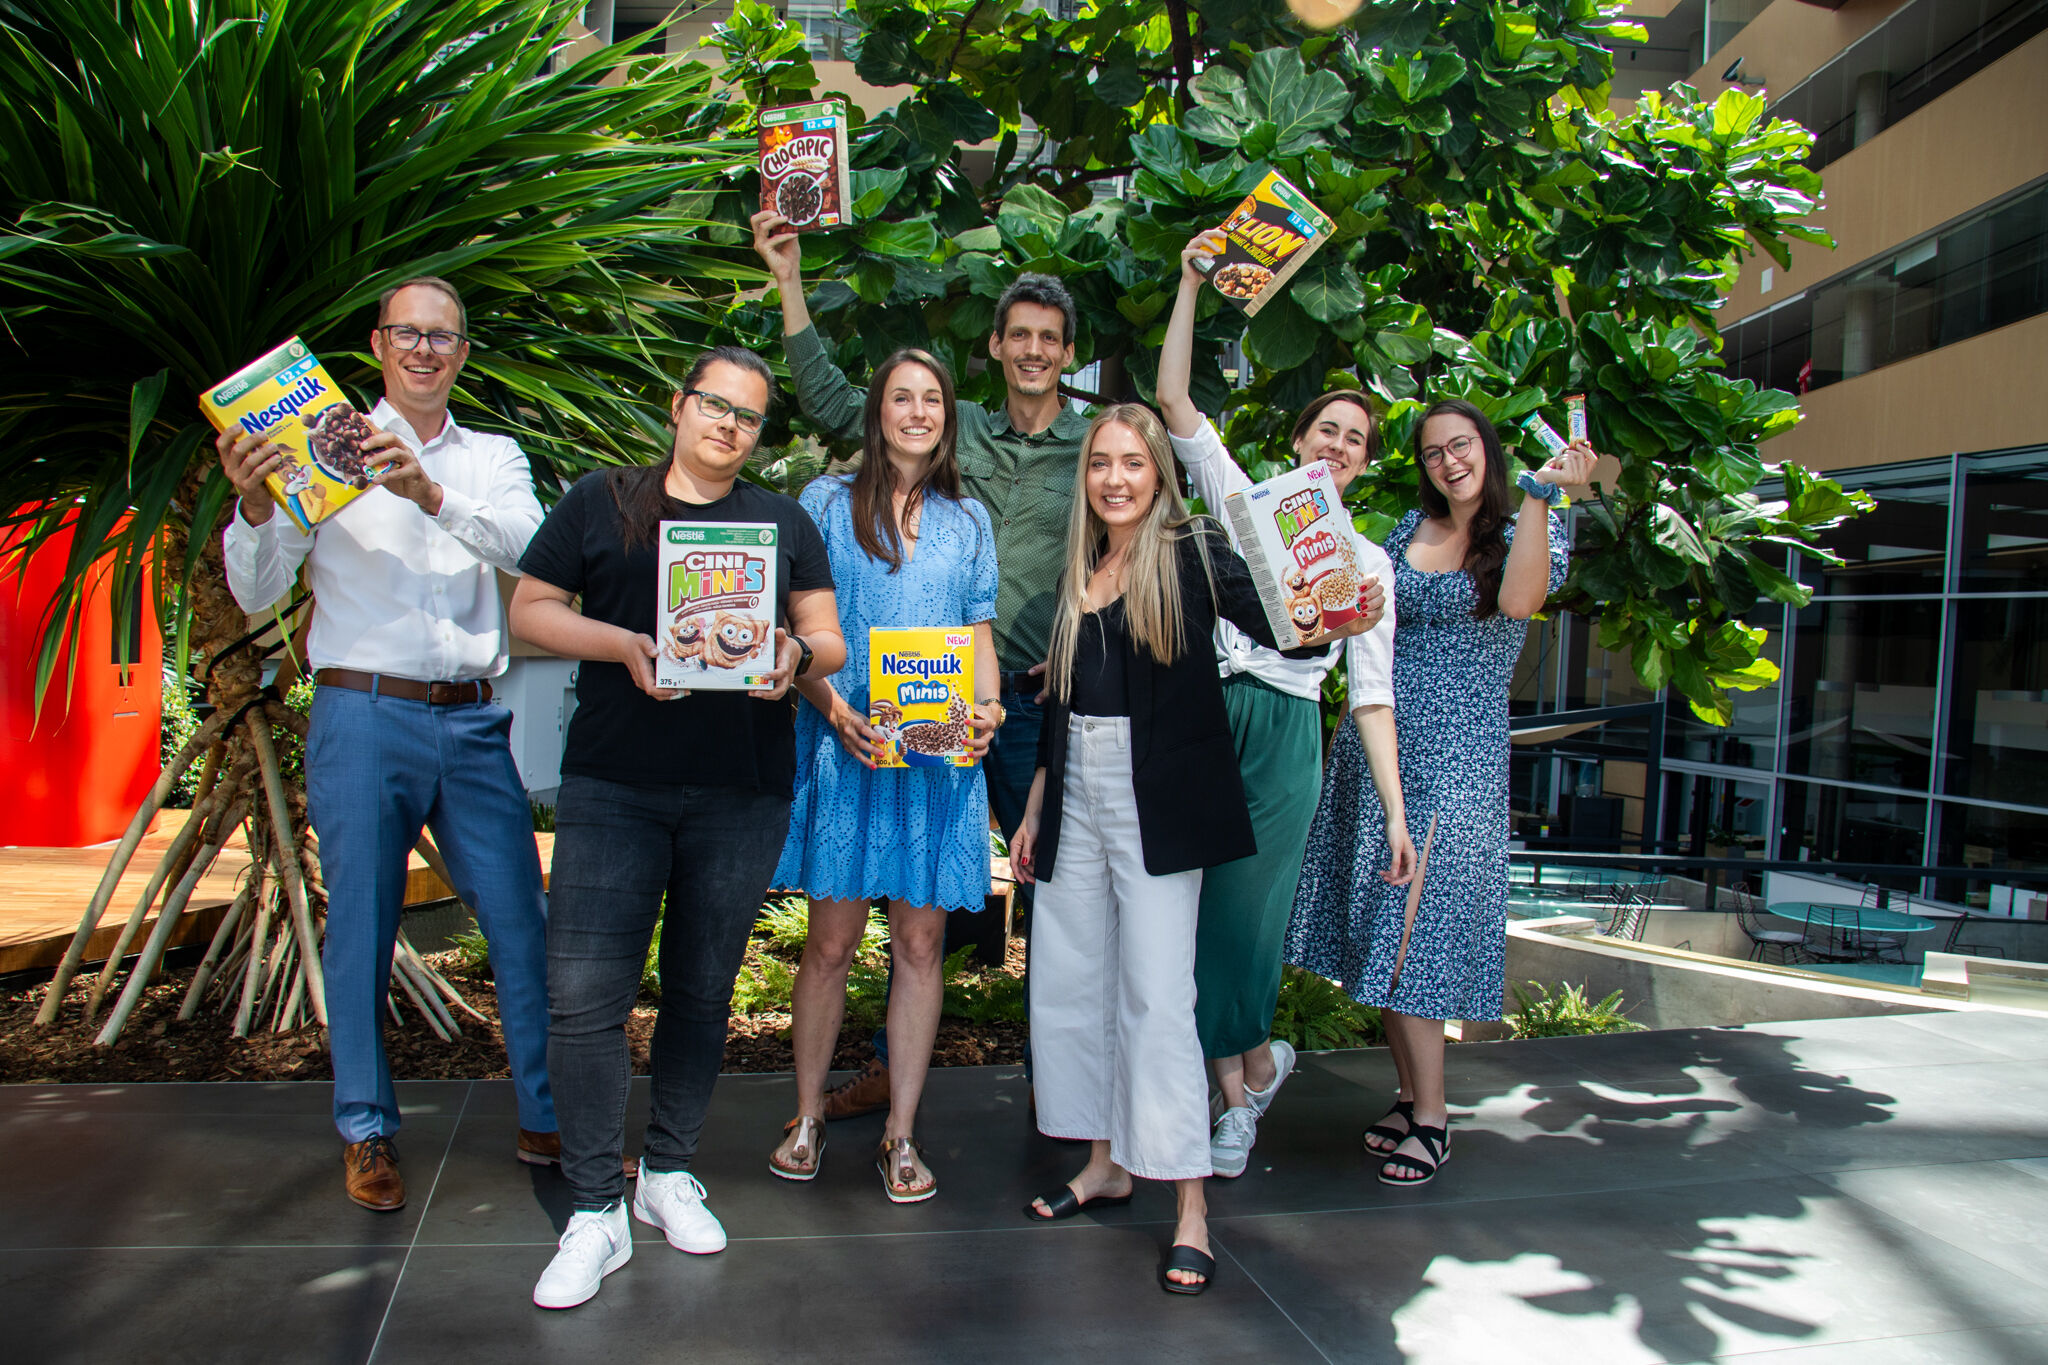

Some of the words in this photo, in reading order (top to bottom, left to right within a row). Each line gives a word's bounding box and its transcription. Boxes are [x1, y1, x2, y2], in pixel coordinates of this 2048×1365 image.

[806, 120, 816, 129] 12
[764, 138, 830, 177] CHOCAPIC
[1236, 217, 1307, 258] LION
[279, 370, 295, 383] 12
[240, 377, 326, 435] Nesquik
[1307, 465, 1327, 481] NEW!
[1281, 490, 1313, 514] CINI
[671, 530, 705, 541] Nestlé
[1296, 535, 1335, 566] Minis
[686, 554, 744, 570] CINI
[946, 636, 970, 645] NEW!
[882, 653, 962, 680] Nesquik
[900, 683, 948, 702] Minis
